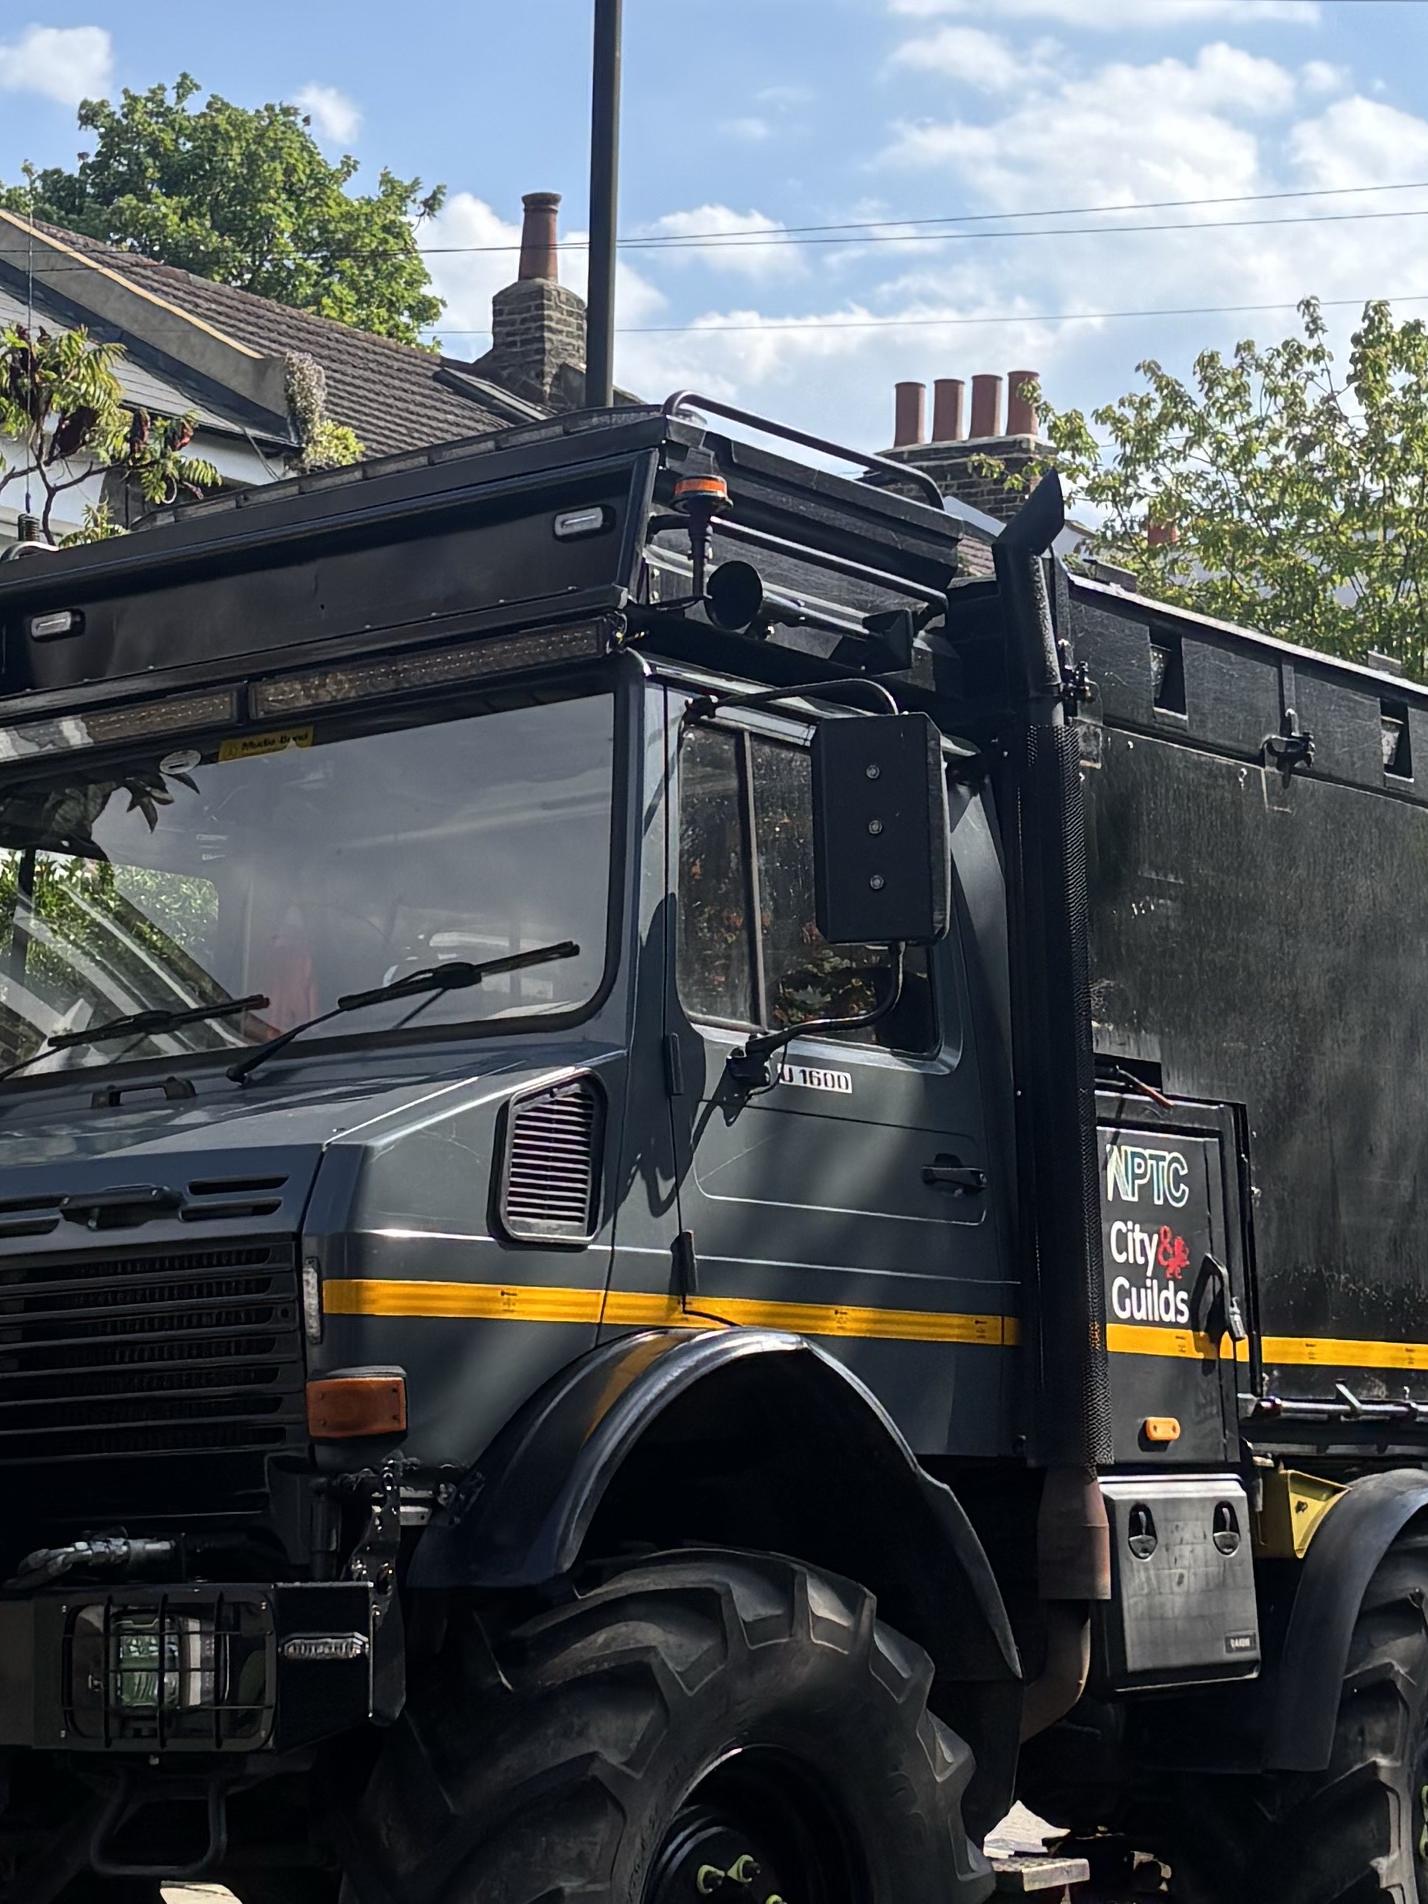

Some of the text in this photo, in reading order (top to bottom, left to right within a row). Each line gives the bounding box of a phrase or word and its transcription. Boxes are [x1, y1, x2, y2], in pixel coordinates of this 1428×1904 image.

[799, 1069, 849, 1090] 1600
[1106, 1143, 1190, 1208] NPTC
[1111, 1276, 1190, 1324] Guilds
